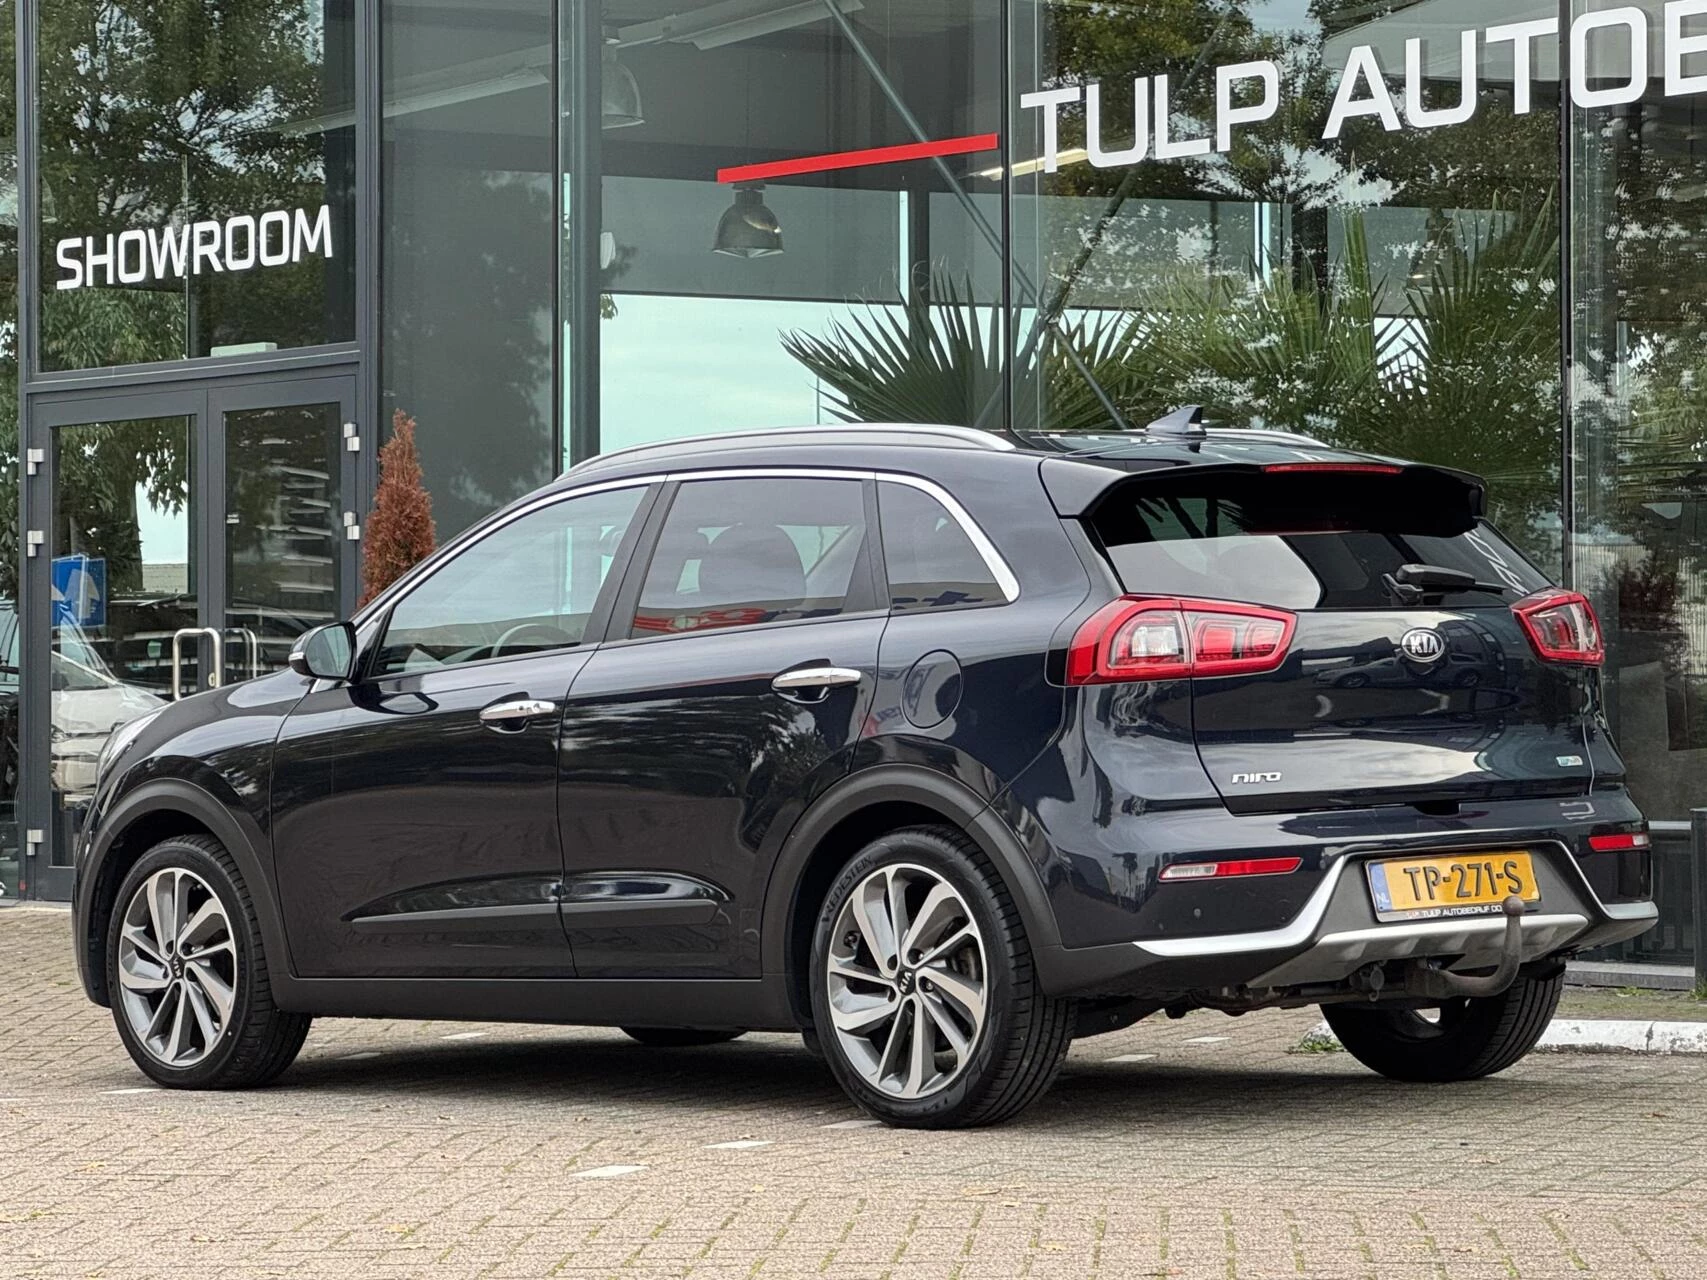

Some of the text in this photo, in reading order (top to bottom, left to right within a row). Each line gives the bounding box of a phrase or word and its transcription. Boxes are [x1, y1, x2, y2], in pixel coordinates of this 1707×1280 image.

[1020, 60, 1279, 173] TULP
[56, 204, 333, 290] SHOWROOM
[1409, 635, 1439, 654] KIA
[1403, 861, 1523, 902] TP-271-S
